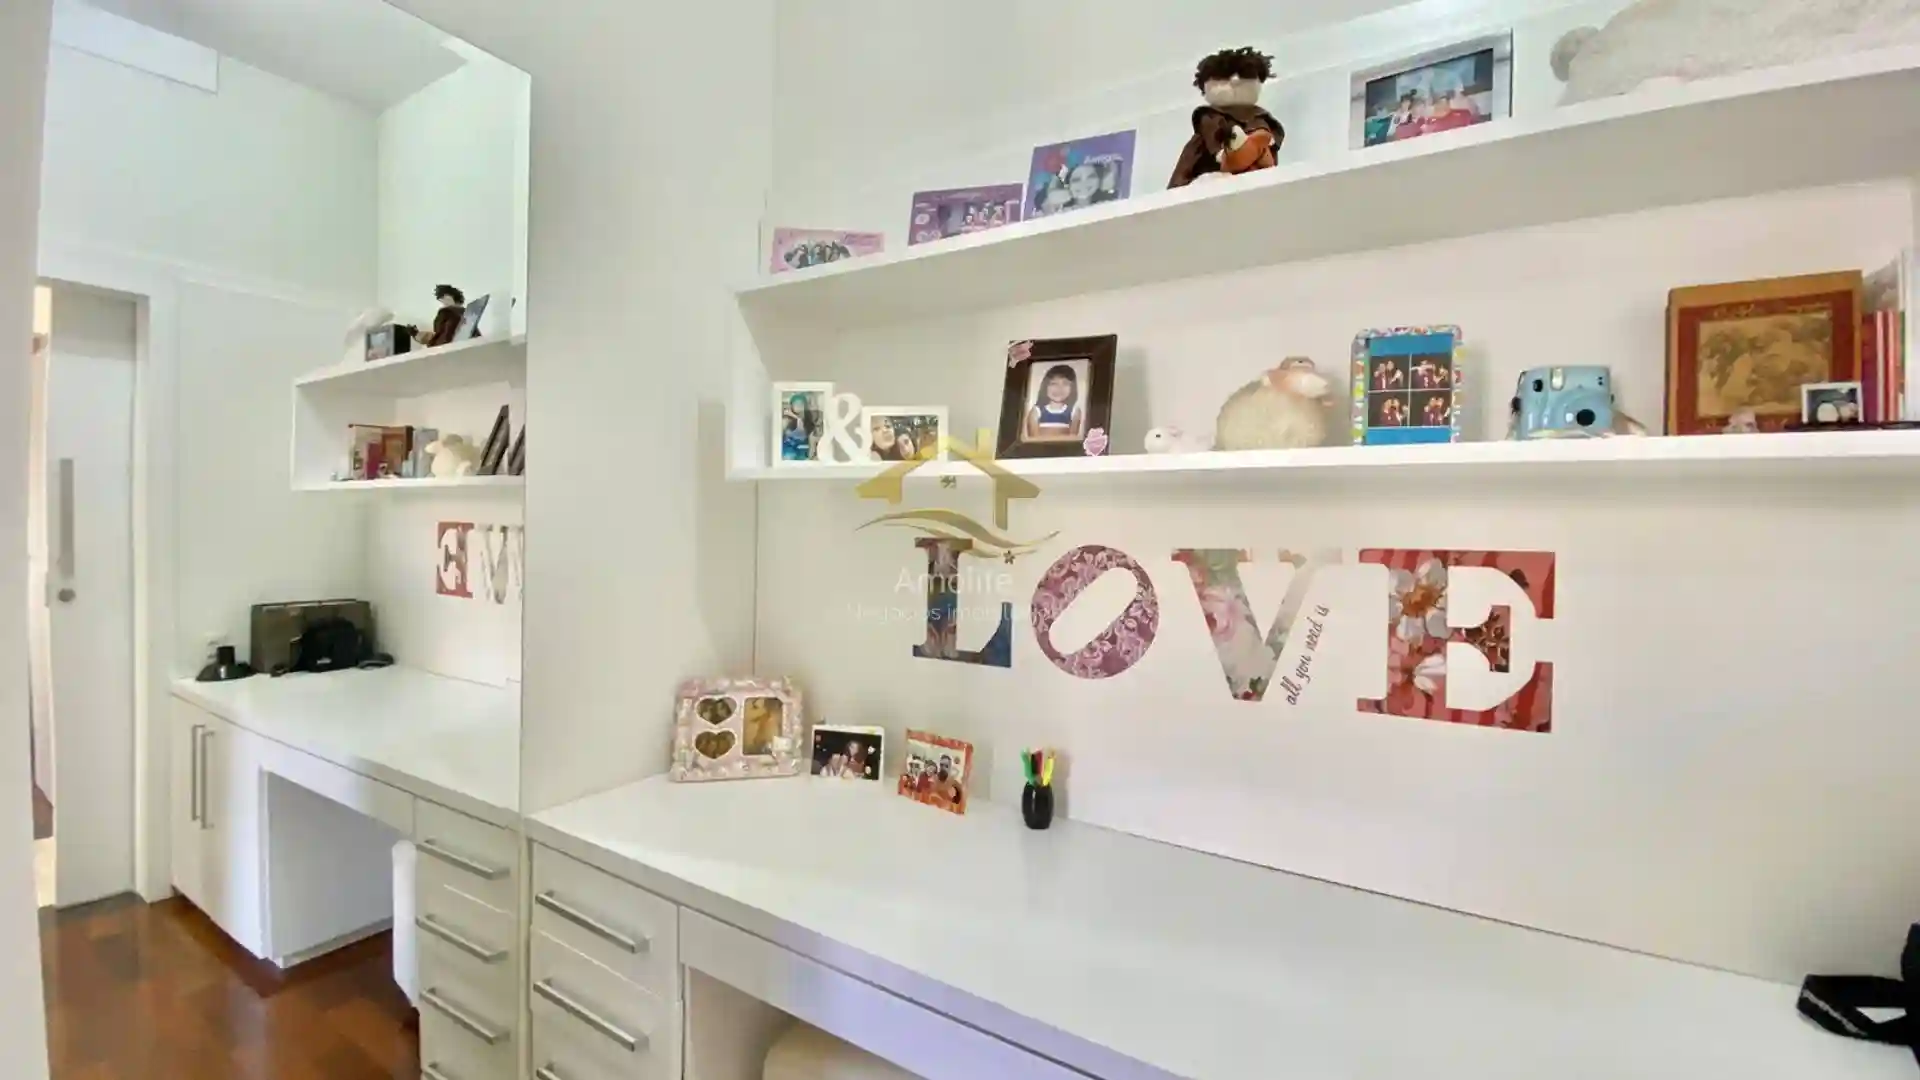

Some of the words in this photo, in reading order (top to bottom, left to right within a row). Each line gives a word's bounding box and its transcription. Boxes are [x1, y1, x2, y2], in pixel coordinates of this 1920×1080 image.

[912, 536, 1556, 734] LOVE
[1280, 675, 1303, 706] all
[1294, 655, 1313, 684] you
[1305, 616, 1323, 652] need
